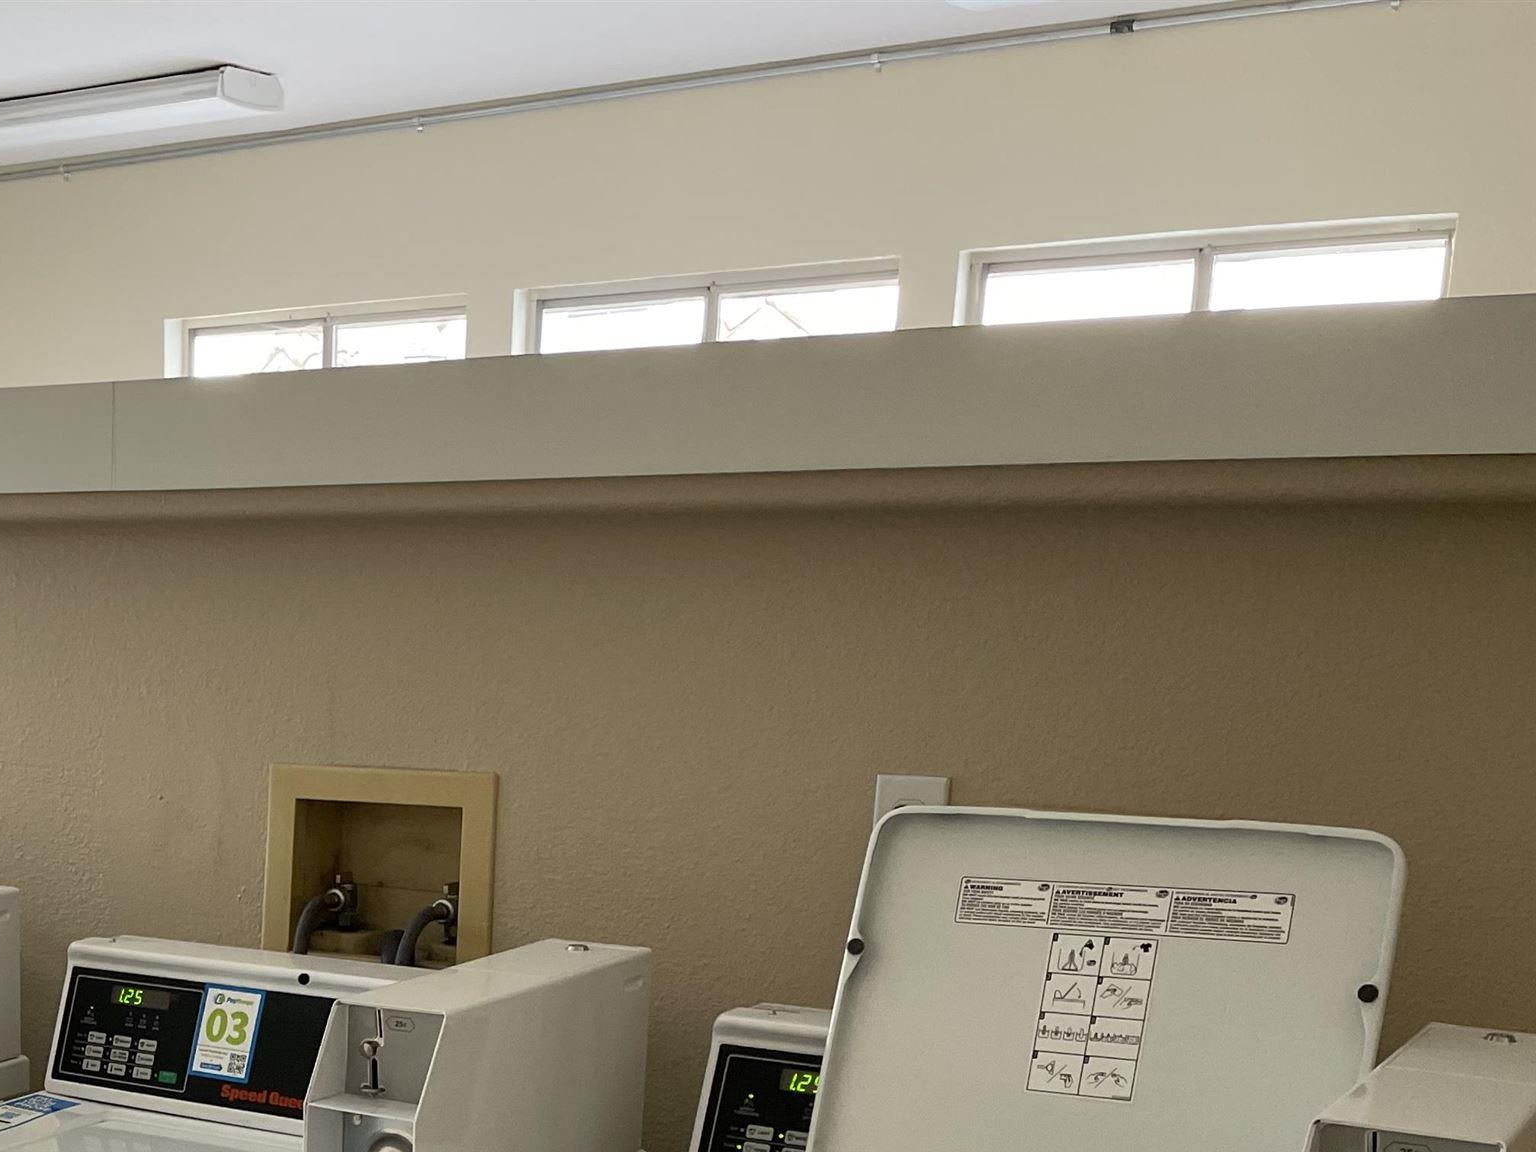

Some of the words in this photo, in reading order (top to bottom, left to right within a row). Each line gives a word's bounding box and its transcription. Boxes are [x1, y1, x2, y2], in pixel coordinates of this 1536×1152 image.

[970, 884, 1003, 892] WARNING
[1062, 889, 1124, 898] AVERTISSEMENT
[1181, 895, 1237, 904] ADVERTENCIA
[205, 1008, 249, 1045] 03
[220, 1084, 268, 1105] Speed
[269, 1092, 303, 1109] Ques
